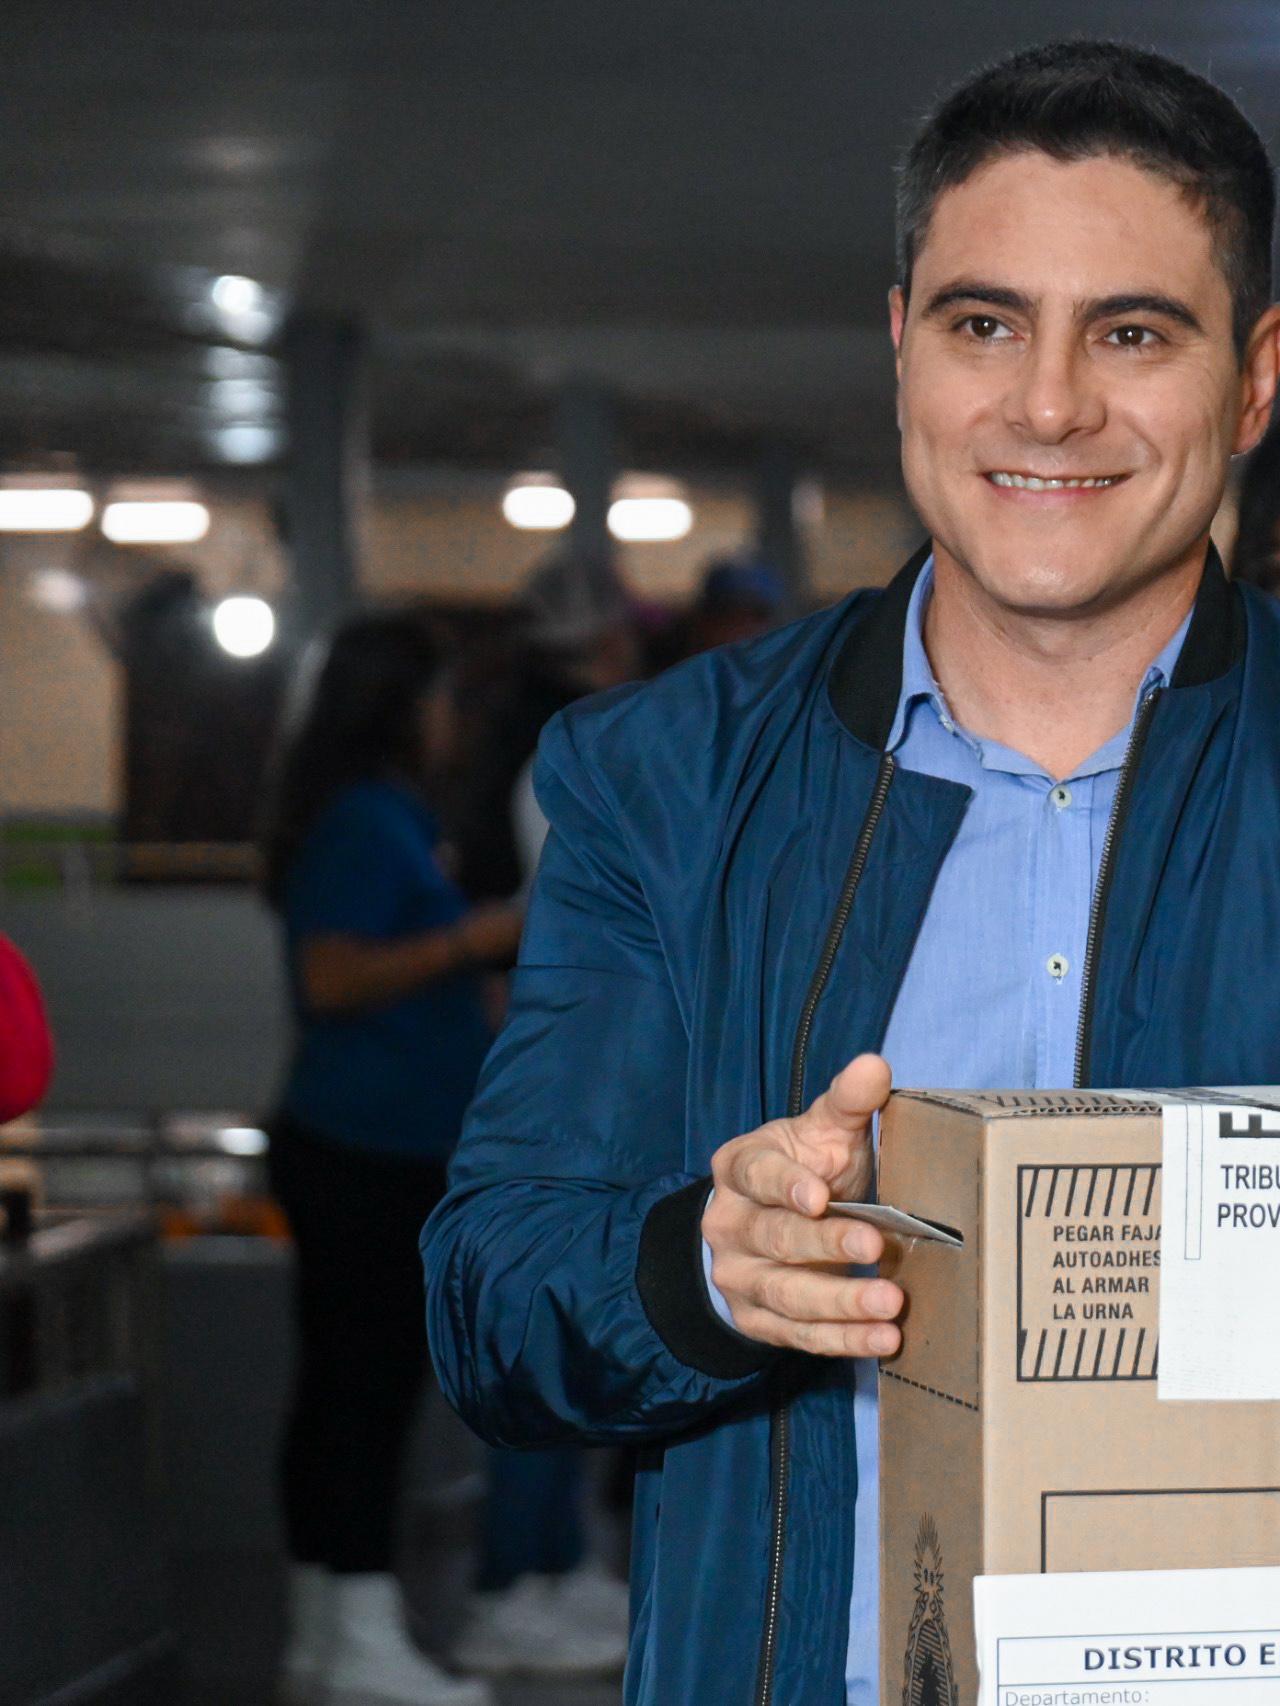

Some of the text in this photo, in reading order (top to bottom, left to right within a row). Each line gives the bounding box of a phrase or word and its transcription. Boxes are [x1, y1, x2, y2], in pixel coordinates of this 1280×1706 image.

[1053, 1224, 1114, 1241] PEGAR
[1052, 1276, 1149, 1293] AL ARMAR
[1053, 1302, 1134, 1320] LA URNA
[1084, 1643, 1247, 1671] DISTRITO
[1005, 1688, 1150, 1706] Departamento:
